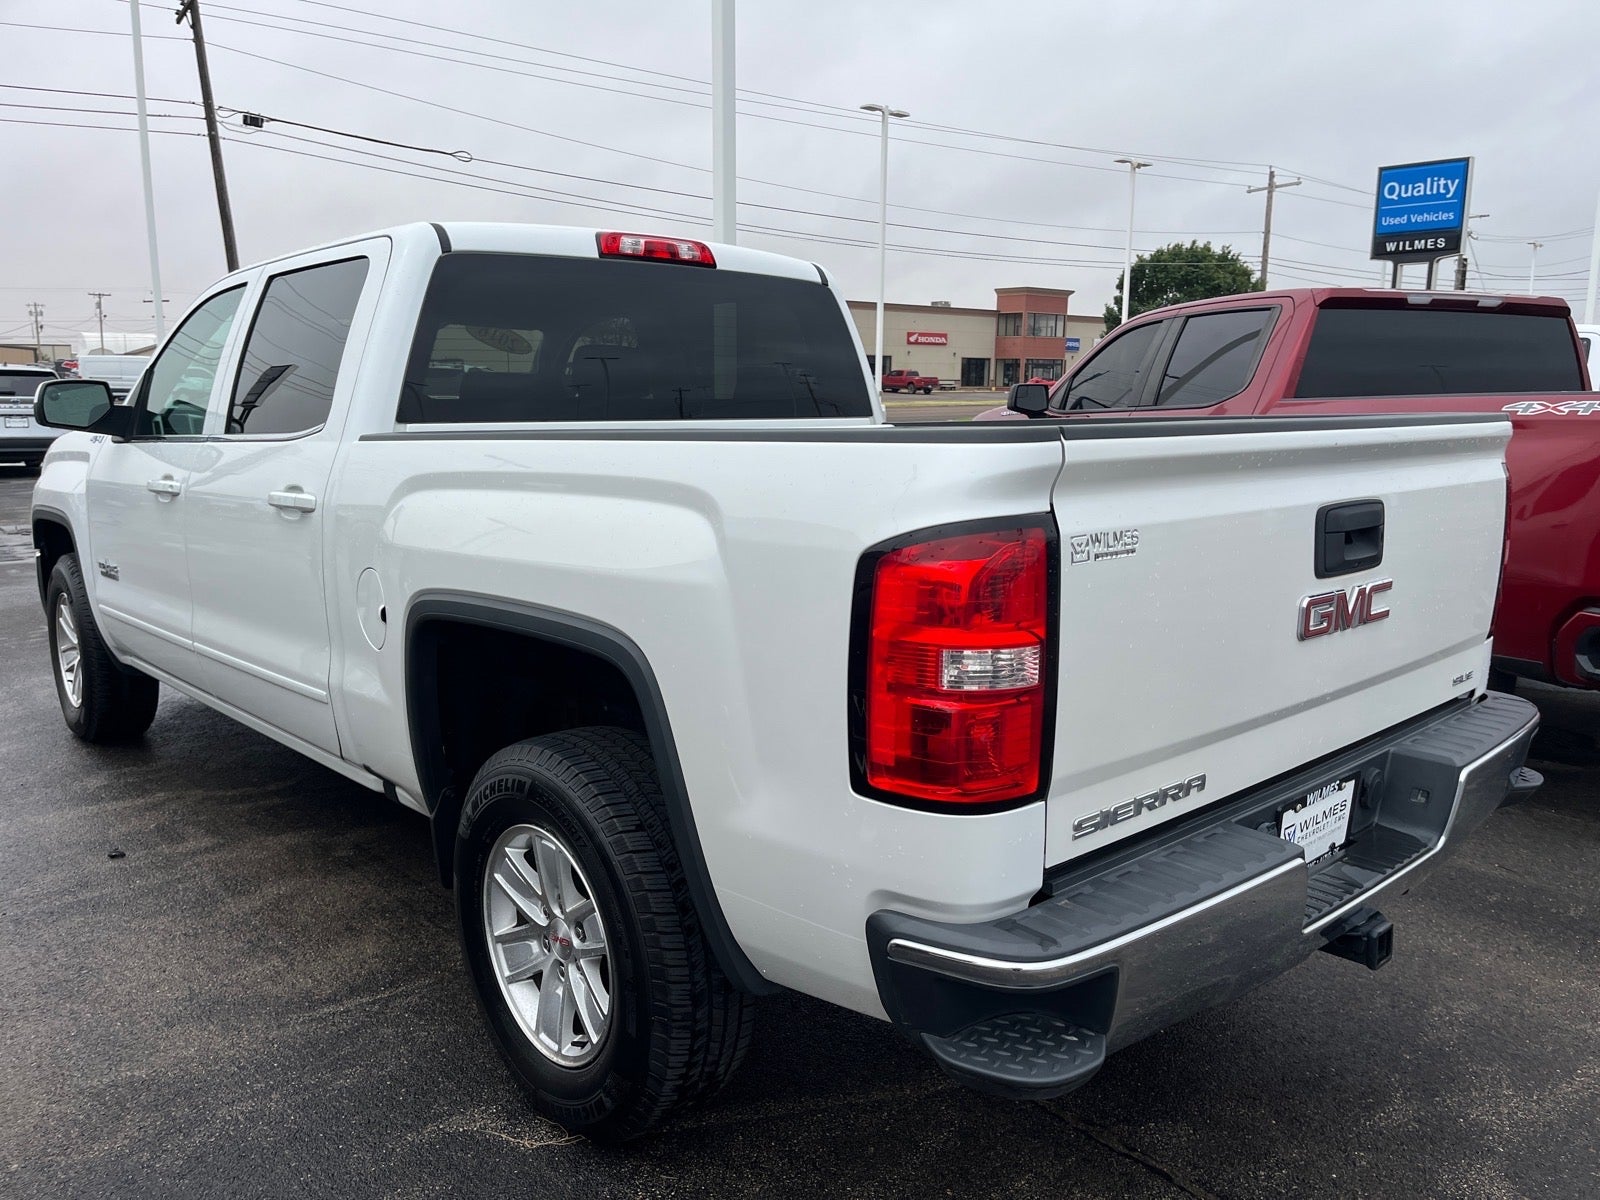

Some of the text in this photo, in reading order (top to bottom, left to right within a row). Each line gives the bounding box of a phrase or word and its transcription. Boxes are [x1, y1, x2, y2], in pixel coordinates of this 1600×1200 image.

[1383, 177, 1460, 200] Quality
[1381, 211, 1455, 226] Used Vehicles
[1385, 238, 1446, 252] WILMES
[918, 336, 947, 344] HONDA
[1089, 528, 1140, 552] WILMES
[1296, 578, 1393, 641] GMC
[471, 777, 530, 816] MICHELIN
[1306, 780, 1340, 807] WILMES
[1072, 772, 1207, 842] SIERRA
[1299, 799, 1347, 833] WILMES
